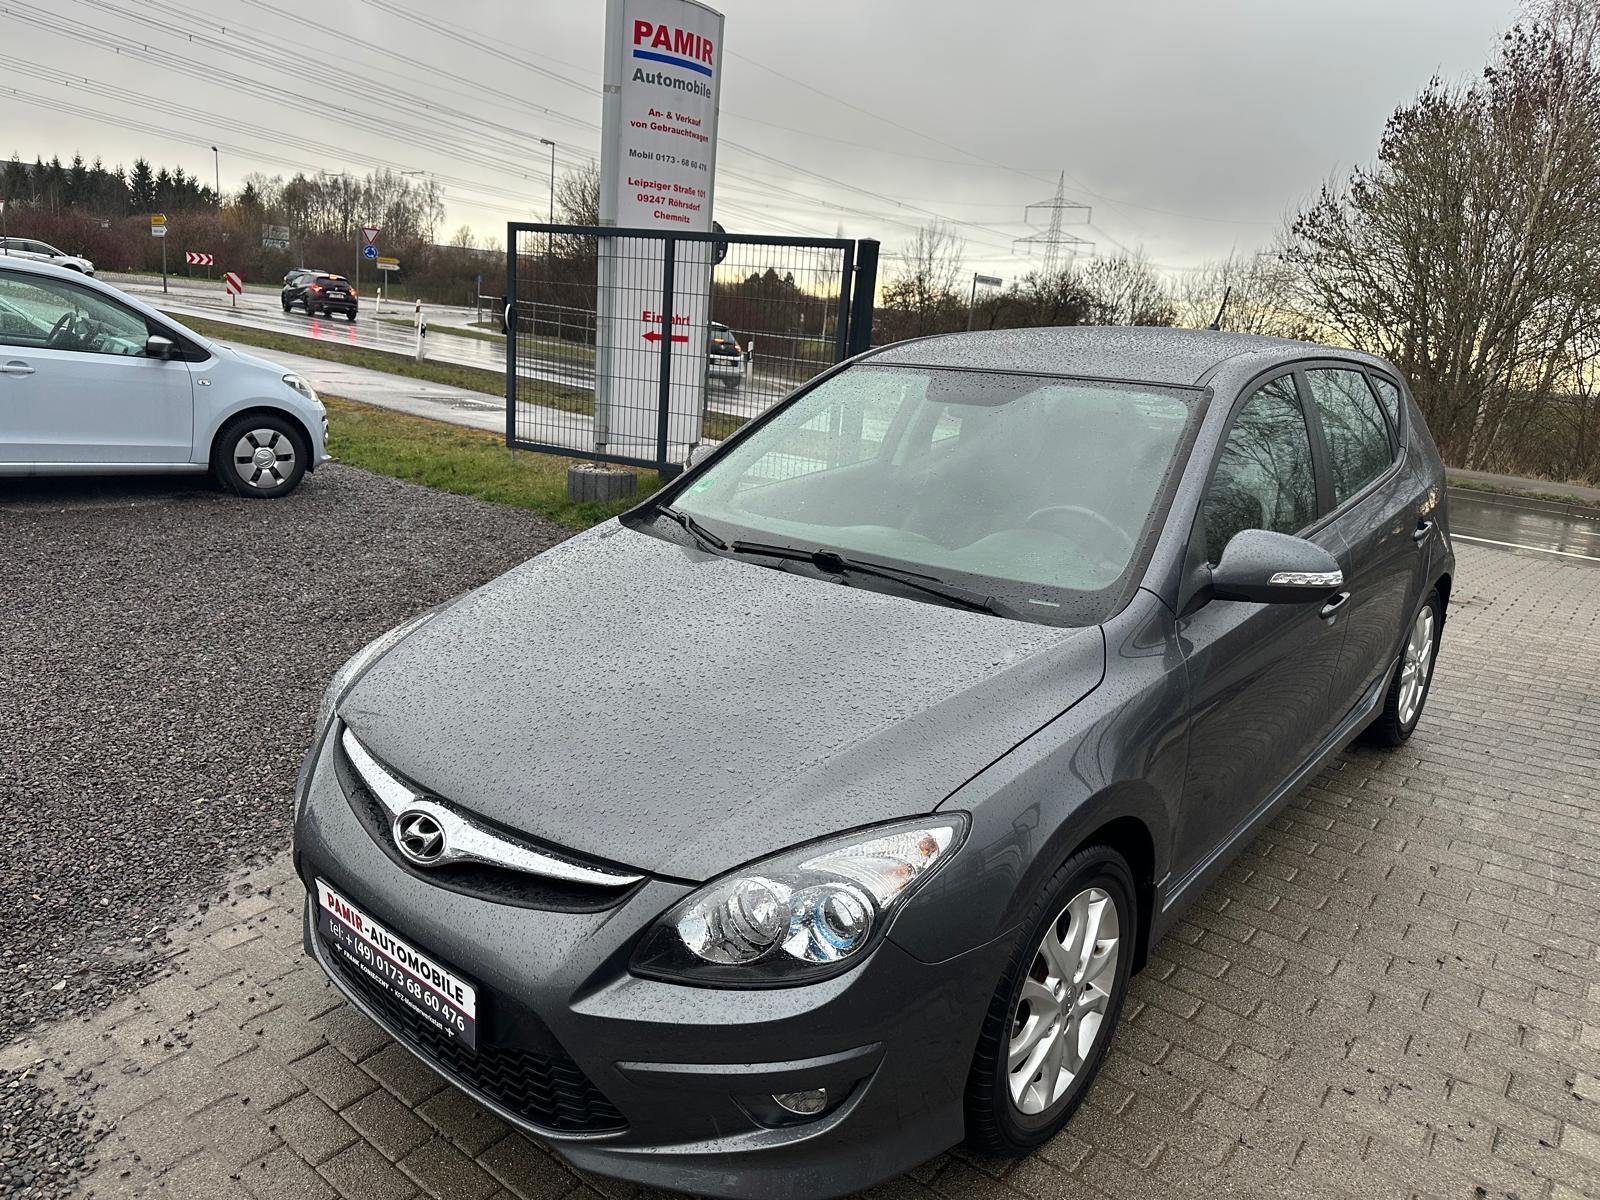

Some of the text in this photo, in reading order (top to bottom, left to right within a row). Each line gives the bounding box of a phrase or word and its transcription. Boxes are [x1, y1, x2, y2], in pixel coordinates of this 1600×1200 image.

[633, 20, 713, 65] PAMIR
[632, 68, 711, 98] Automobile
[648, 108, 664, 118] An-
[675, 113, 701, 127] Verkauf
[630, 120, 709, 142] von Gebrauchtwagen
[629, 149, 653, 160] Mobil
[655, 153, 676, 164] 0173
[681, 158, 690, 167] 68
[691, 160, 697, 169] 60
[628, 177, 706, 198] Leipziger Straße 101
[637, 193, 701, 211] 09247 Röhrsdorf
[653, 210, 690, 223] Chemnitz
[642, 311, 690, 326] Einahrt
[343, 949, 360, 967] FRANK
[329, 919, 344, 940] tel:
[354, 937, 375, 966] (49)
[376, 955, 404, 986] 0173
[406, 978, 422, 999] 68
[424, 991, 439, 1012] 60
[441, 1004, 465, 1031] 476
